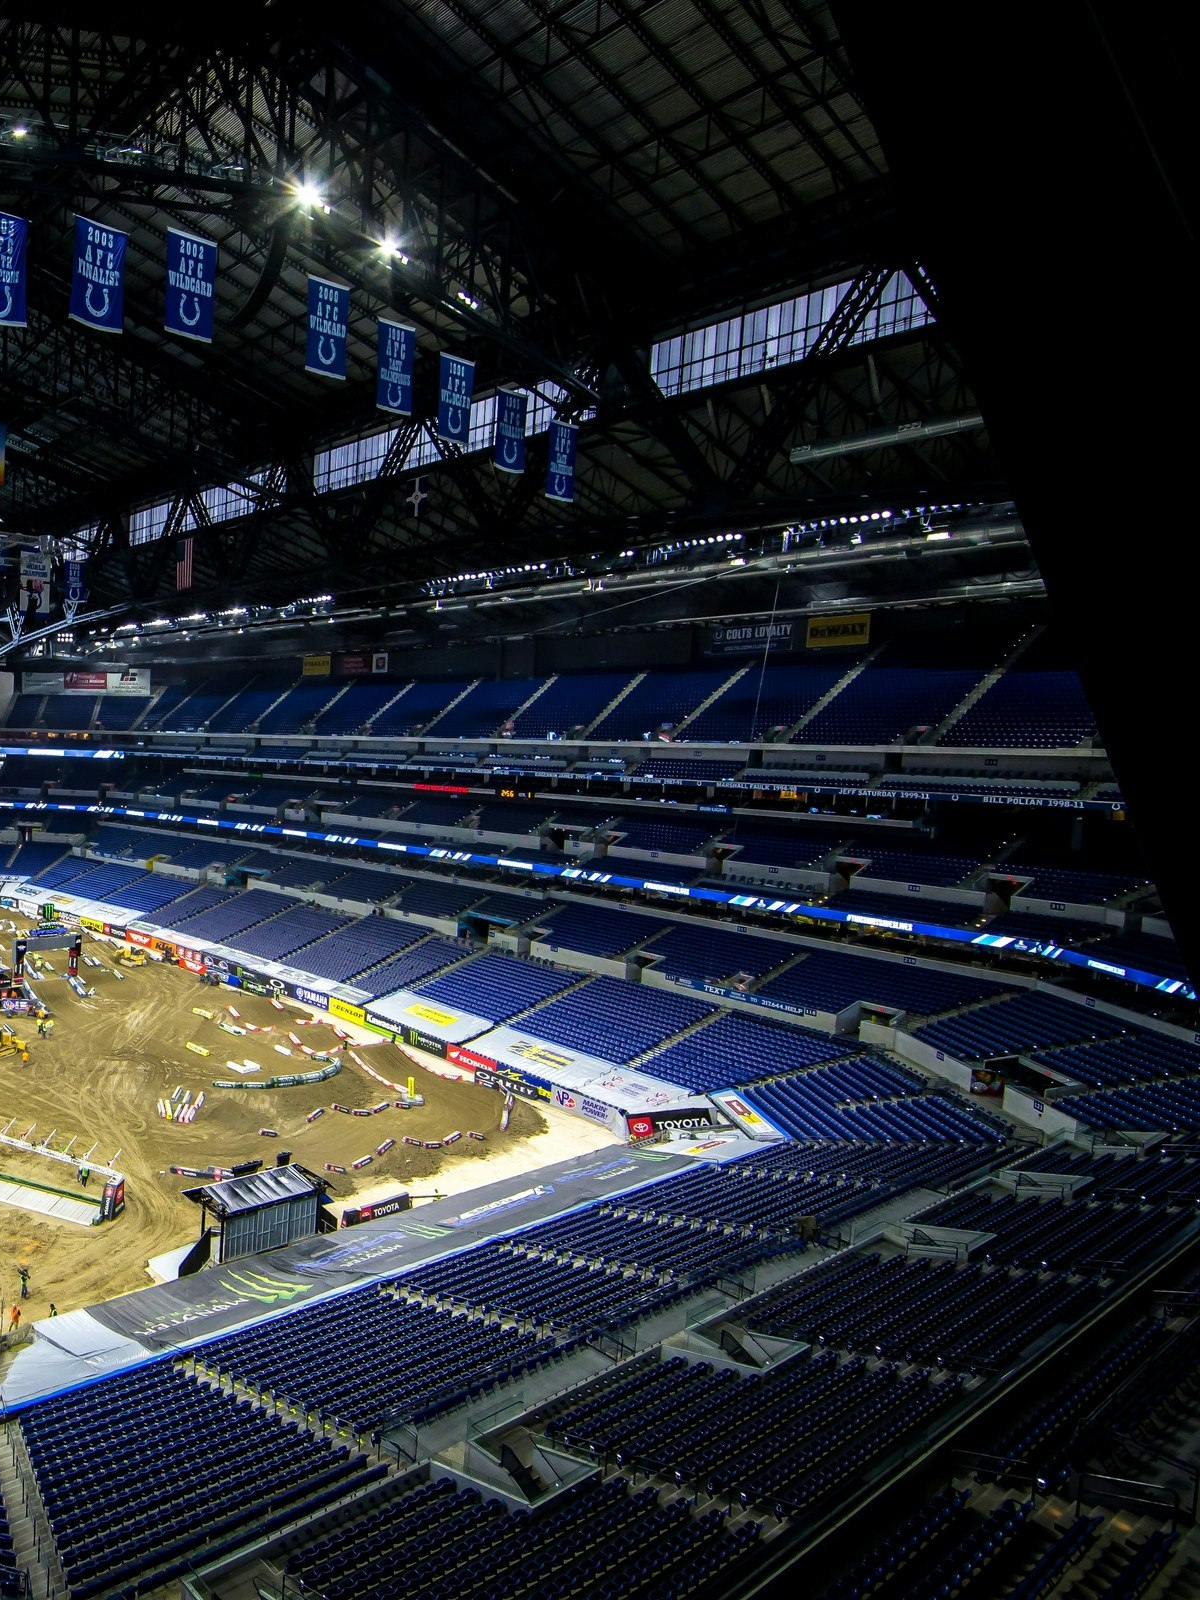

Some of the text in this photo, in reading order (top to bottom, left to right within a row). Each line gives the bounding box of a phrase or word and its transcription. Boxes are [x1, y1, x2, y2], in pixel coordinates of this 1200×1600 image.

[88, 227, 114, 248] 2003
[85, 245, 114, 269] AFC
[180, 239, 204, 259] 2002
[78, 257, 120, 286] FINALIST
[179, 257, 203, 278] AFC
[168, 270, 212, 297] WILDCARD
[317, 302, 338, 321] AFC
[310, 315, 346, 339] WILDCARD
[386, 339, 406, 360] AFC
[447, 376, 465, 394] AFC
[555, 437, 571, 454] AFC
[726, 624, 793, 640] COLTS LOYALTY
[750, 783, 770, 791] FAULK
[838, 788, 930, 800] JEFF SATURDAY 1999-11
[983, 796, 1085, 809] BILL POLIAN 1998-11
[303, 989, 328, 1004] YAMAHA
[704, 984, 725, 996] TEXT
[336, 1004, 364, 1019] DUNLOP
[367, 1014, 401, 1034] Kawasaki
[459, 1056, 493, 1072] HONDA
[582, 1099, 607, 1113] MAKIN'
[582, 1105, 609, 1120] POWER!
[656, 1117, 710, 1130] TOYOTA
[374, 1202, 400, 1217] TOYOTA
[135, 1298, 250, 1336] MONSTER
